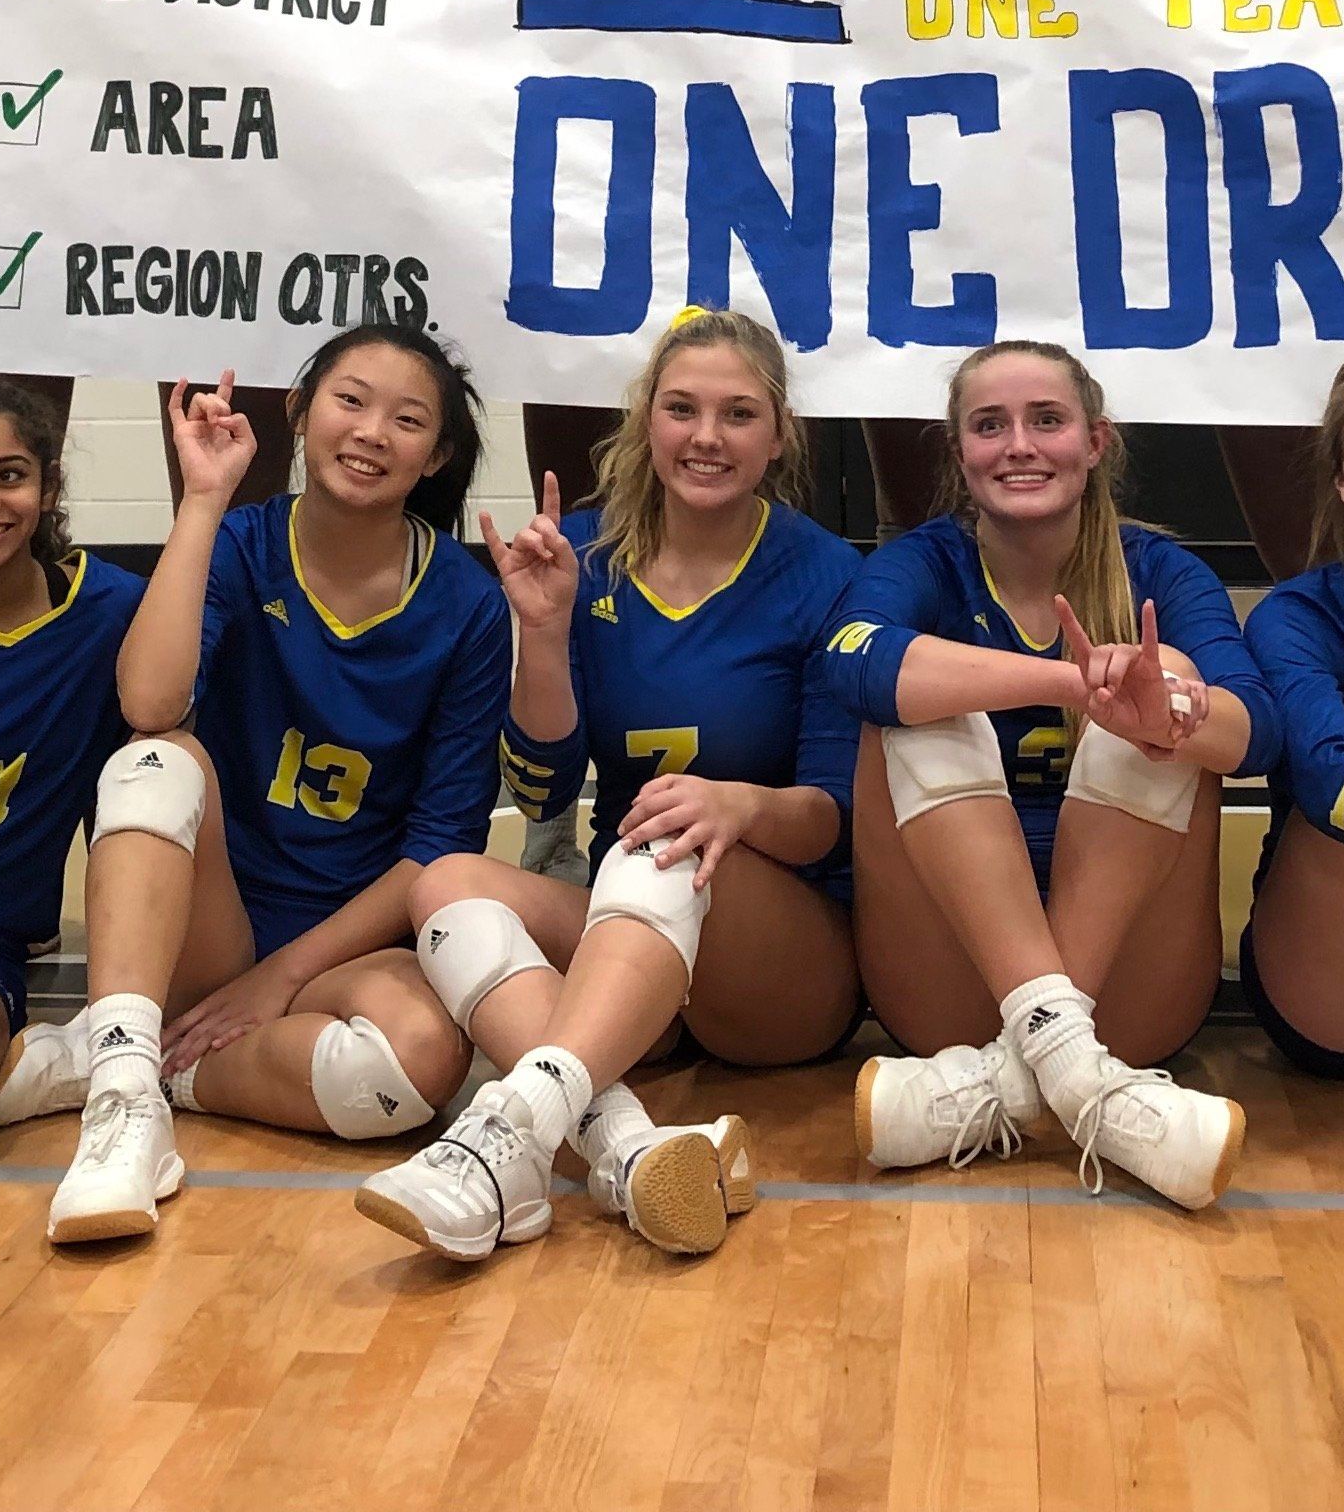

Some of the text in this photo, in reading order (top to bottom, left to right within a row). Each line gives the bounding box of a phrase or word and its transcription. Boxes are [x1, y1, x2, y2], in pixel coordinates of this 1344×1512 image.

[91, 80, 278, 160] AREA
[503, 73, 1000, 353] ONE
[66, 243, 439, 332] REGION QTRS.
[267, 727, 373, 823] 13
